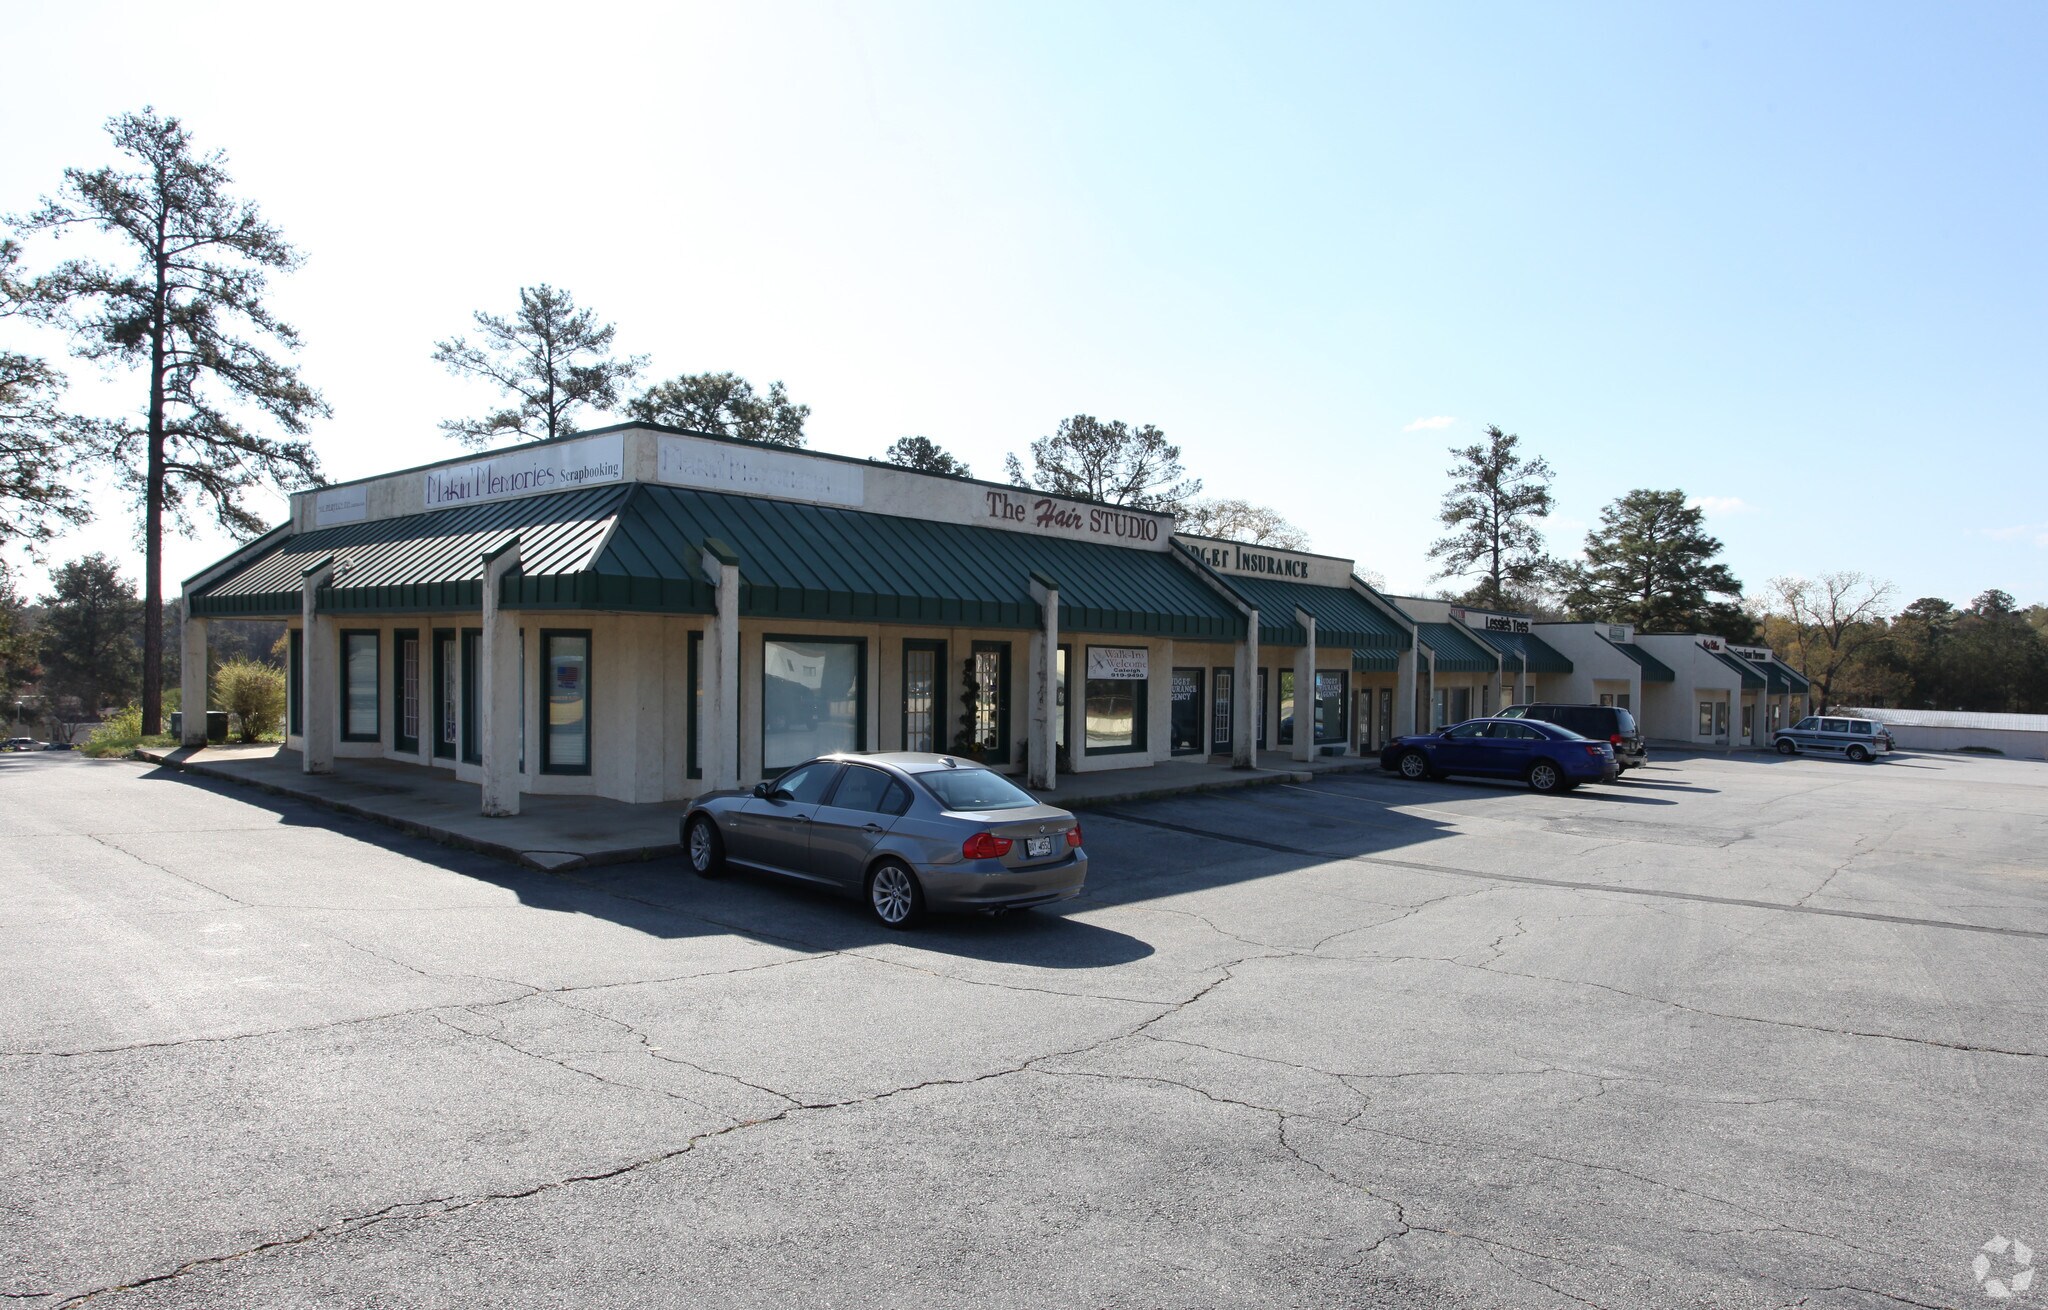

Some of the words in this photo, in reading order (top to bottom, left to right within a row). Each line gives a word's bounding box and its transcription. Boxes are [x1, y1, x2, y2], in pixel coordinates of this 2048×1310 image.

[476, 462, 555, 497] Memories
[560, 461, 619, 483] Scrapbooking
[987, 491, 1025, 522] The
[1034, 499, 1083, 529] Hair
[1090, 508, 1158, 541] STUDIO
[1235, 546, 1308, 578] INSURANCE
[1512, 619, 1529, 633] Tees
[1104, 649, 1145, 659] Walk-Ins
[1106, 659, 1147, 668] Welcome
